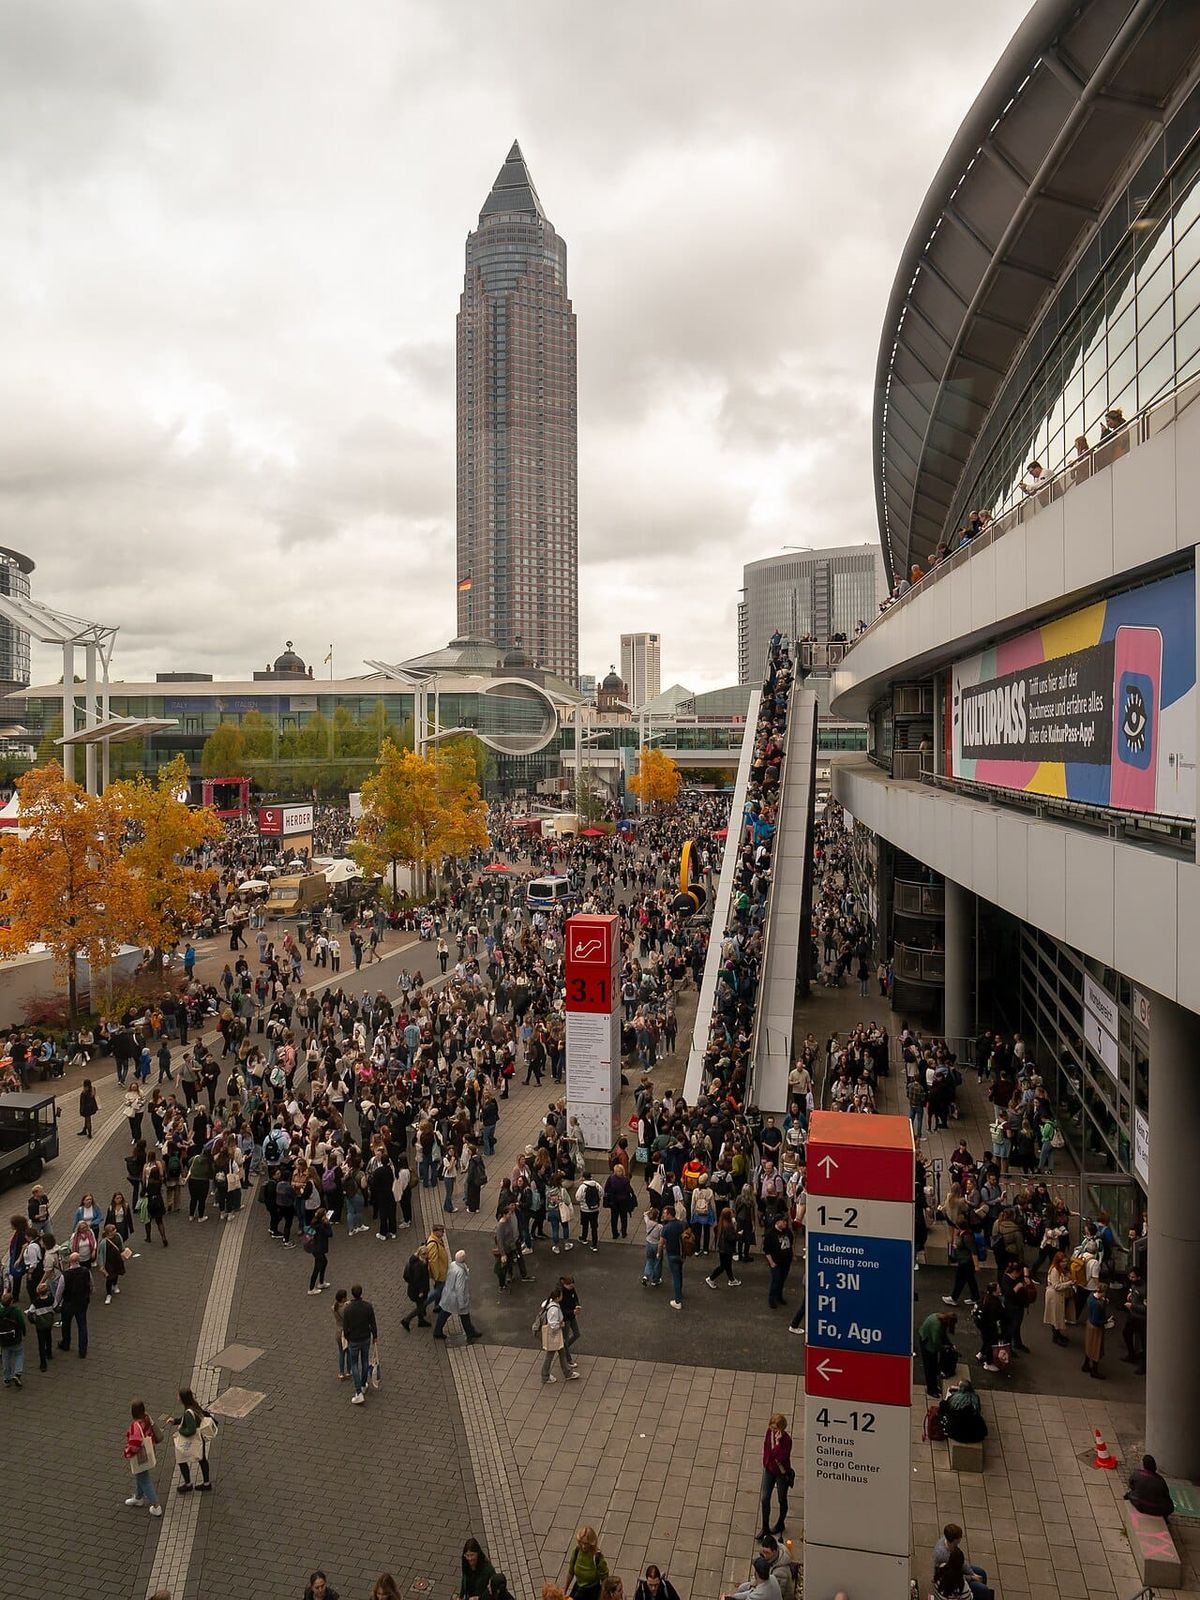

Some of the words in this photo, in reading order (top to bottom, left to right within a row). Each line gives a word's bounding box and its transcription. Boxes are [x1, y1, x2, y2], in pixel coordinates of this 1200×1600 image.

[1039, 680, 1048, 694] uns
[1048, 673, 1057, 692] hier
[1059, 668, 1067, 690] auf
[1068, 667, 1078, 687] der
[1029, 701, 1055, 720] Buchmesse
[1055, 696, 1066, 717] und
[1067, 694, 1087, 716] erfahre
[1088, 691, 1104, 712] alles
[1029, 725, 1039, 744] über
[1040, 725, 1048, 743] die
[1048, 721, 1095, 747] KulturPass-App!
[285, 813, 311, 827] HERDER
[571, 978, 606, 1004] 3.1
[817, 1241, 865, 1255] Ladezone
[817, 1254, 855, 1269] Loading
[857, 1259, 880, 1269] zone
[816, 1271, 830, 1290] 1,
[836, 1271, 861, 1291] 3N
[817, 1295, 837, 1313] P1
[817, 1319, 842, 1340] Fo,
[847, 1322, 882, 1344] Ago
[816, 1433, 855, 1446] Torhaus
[816, 1445, 854, 1458] Galleria
[816, 1457, 845, 1470] Cargo
[847, 1461, 881, 1473] Center
[816, 1469, 869, 1484] Portalhaus
